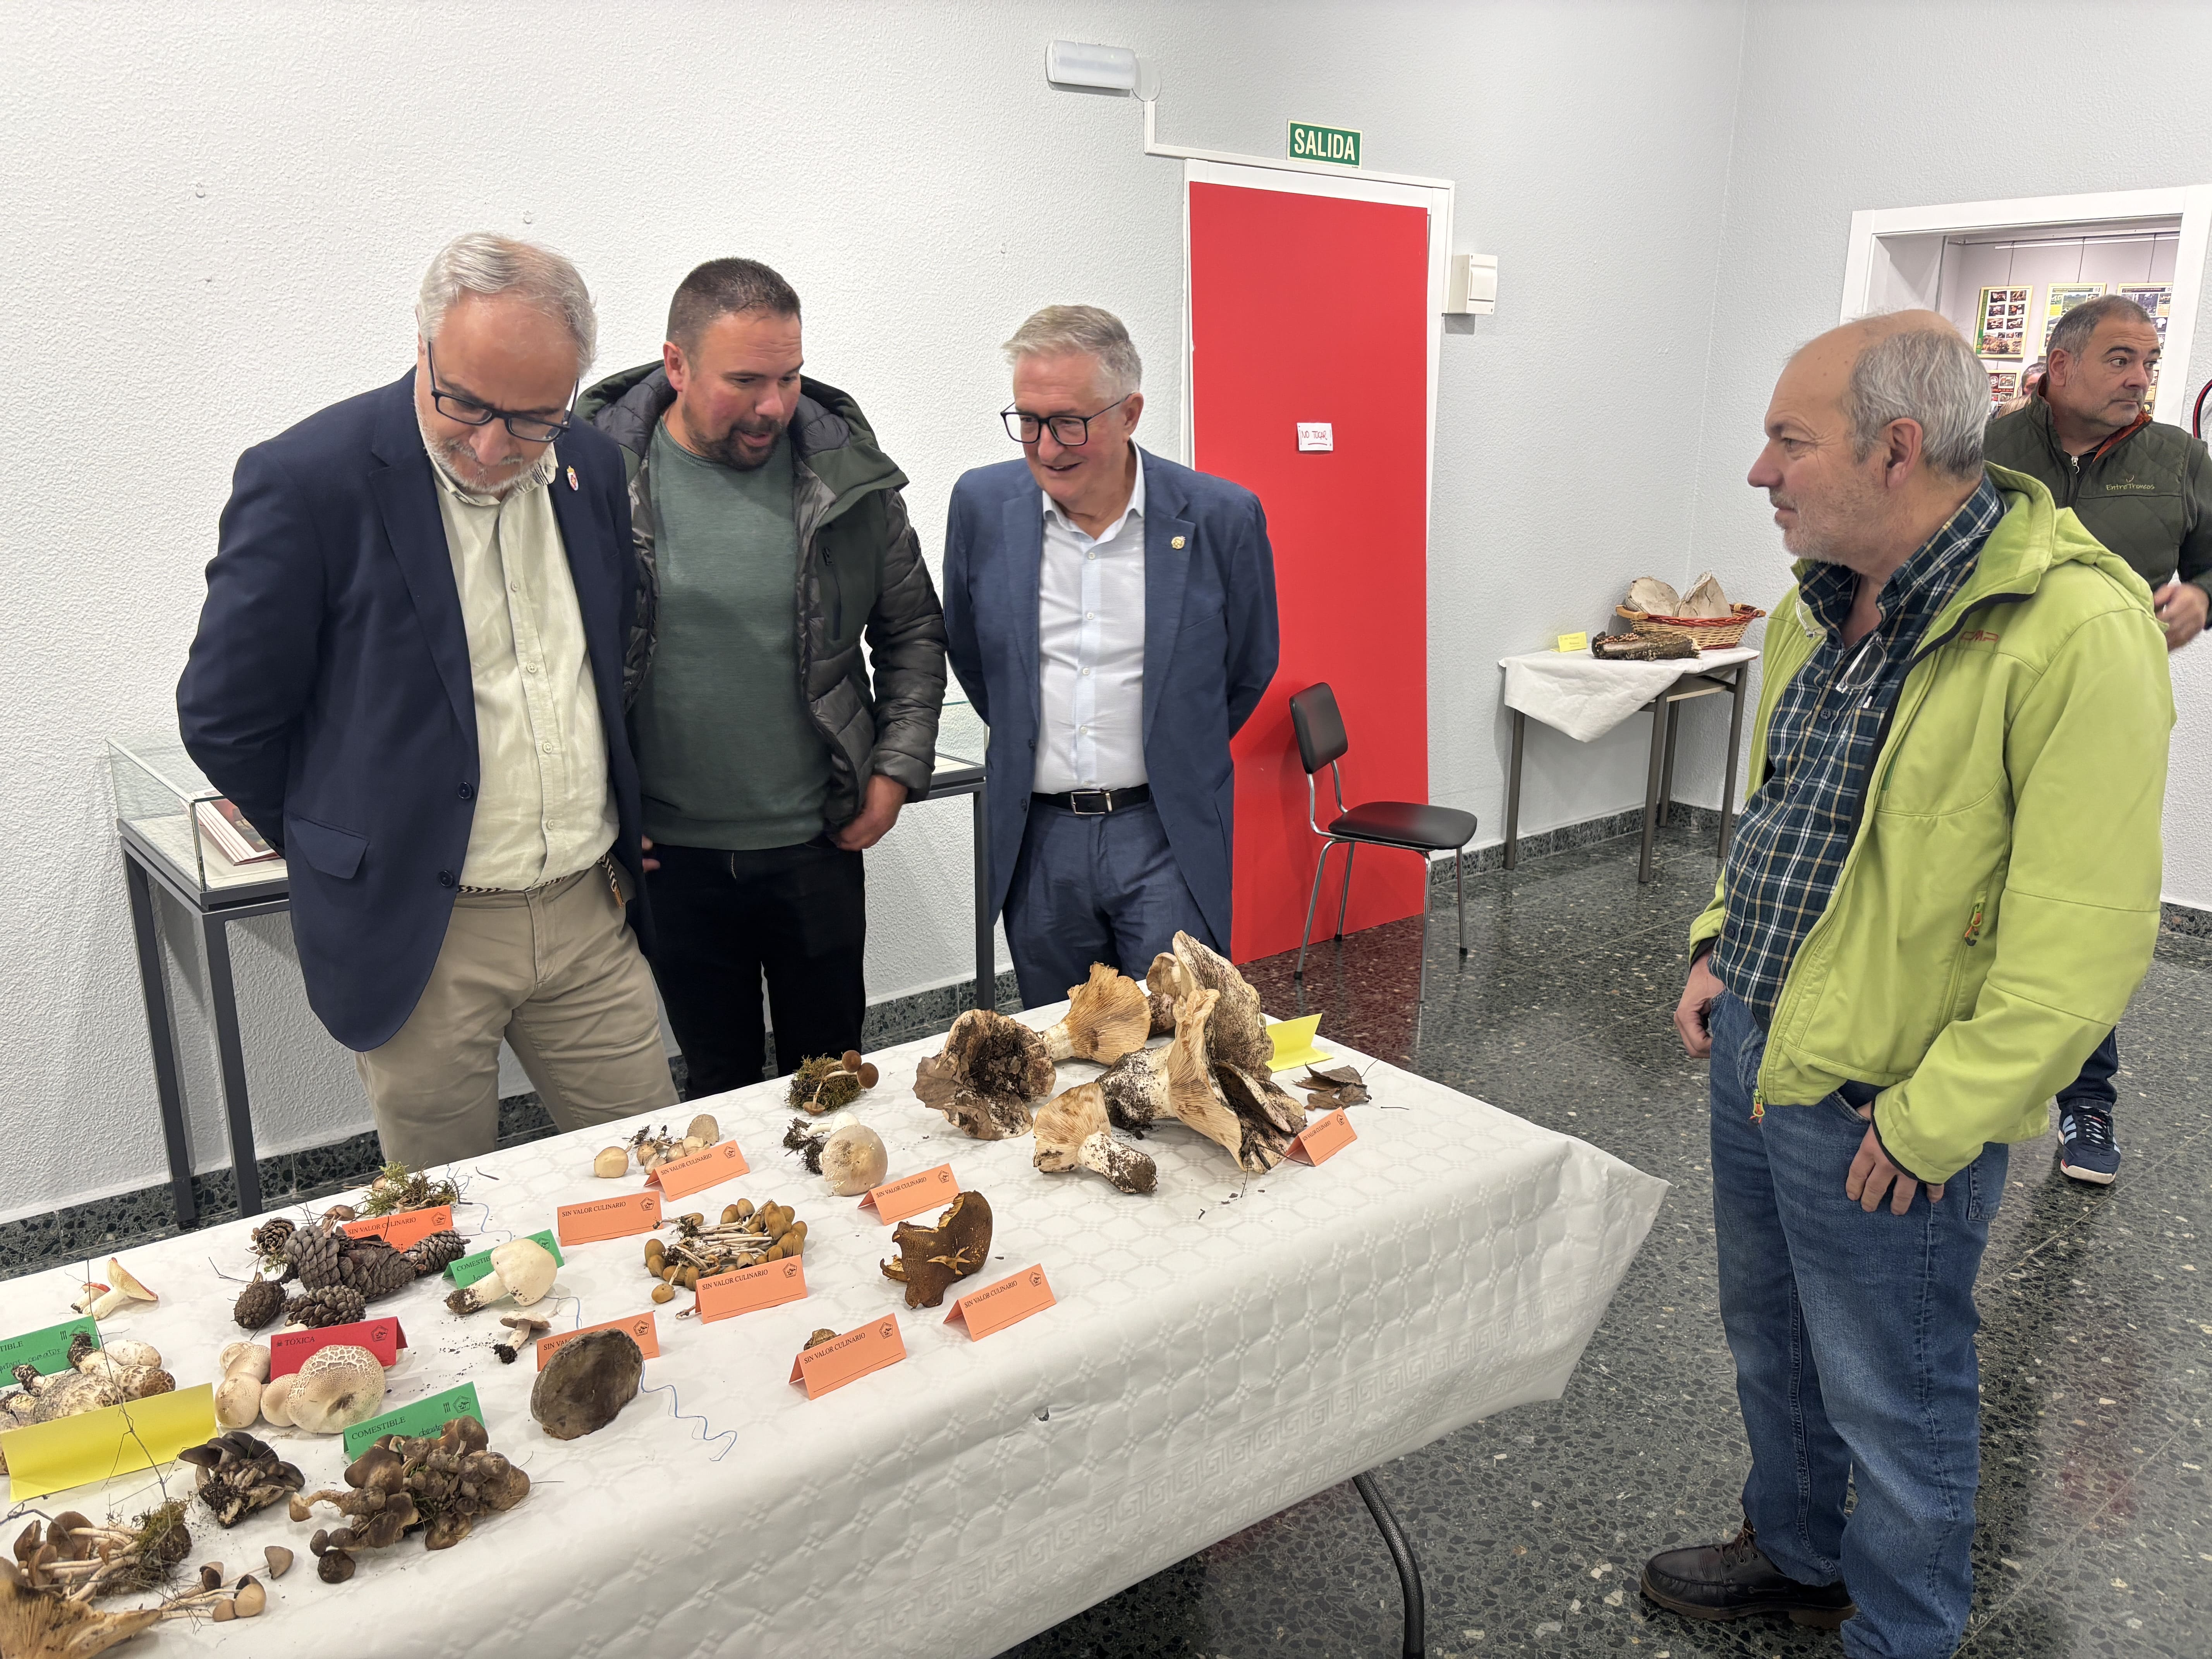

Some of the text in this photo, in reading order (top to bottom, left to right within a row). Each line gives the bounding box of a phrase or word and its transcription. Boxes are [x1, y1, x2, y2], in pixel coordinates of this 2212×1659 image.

[1294, 128, 1355, 161] SALIDA
[1302, 430, 1309, 438] NO
[1960, 630, 1999, 641] CMP
[669, 1163, 686, 1172] VALOR
[686, 1153, 712, 1166] CULINARIO
[885, 1186, 901, 1194] VALOR
[901, 1176, 927, 1189] CULINARIO
[574, 1207, 592, 1215] VALOR
[594, 1201, 626, 1212] CULINARIO
[360, 1224, 380, 1232] VALOR
[382, 1217, 416, 1228] CULINARIO
[457, 1256, 491, 1271] COMESTIB
[713, 1278, 734, 1287] VALOR
[735, 1269, 768, 1282] CULINARIO
[964, 1280, 1018, 1308] SIN VALOR CULINARIO
[0, 1341, 24, 1352] TIBLE
[285, 1336, 315, 1346] TÓXICA
[544, 1342, 555, 1350] SIN
[804, 1332, 866, 1364] SIN VALOR CULINARIO
[352, 1416, 406, 1440] COMESTIBLE
